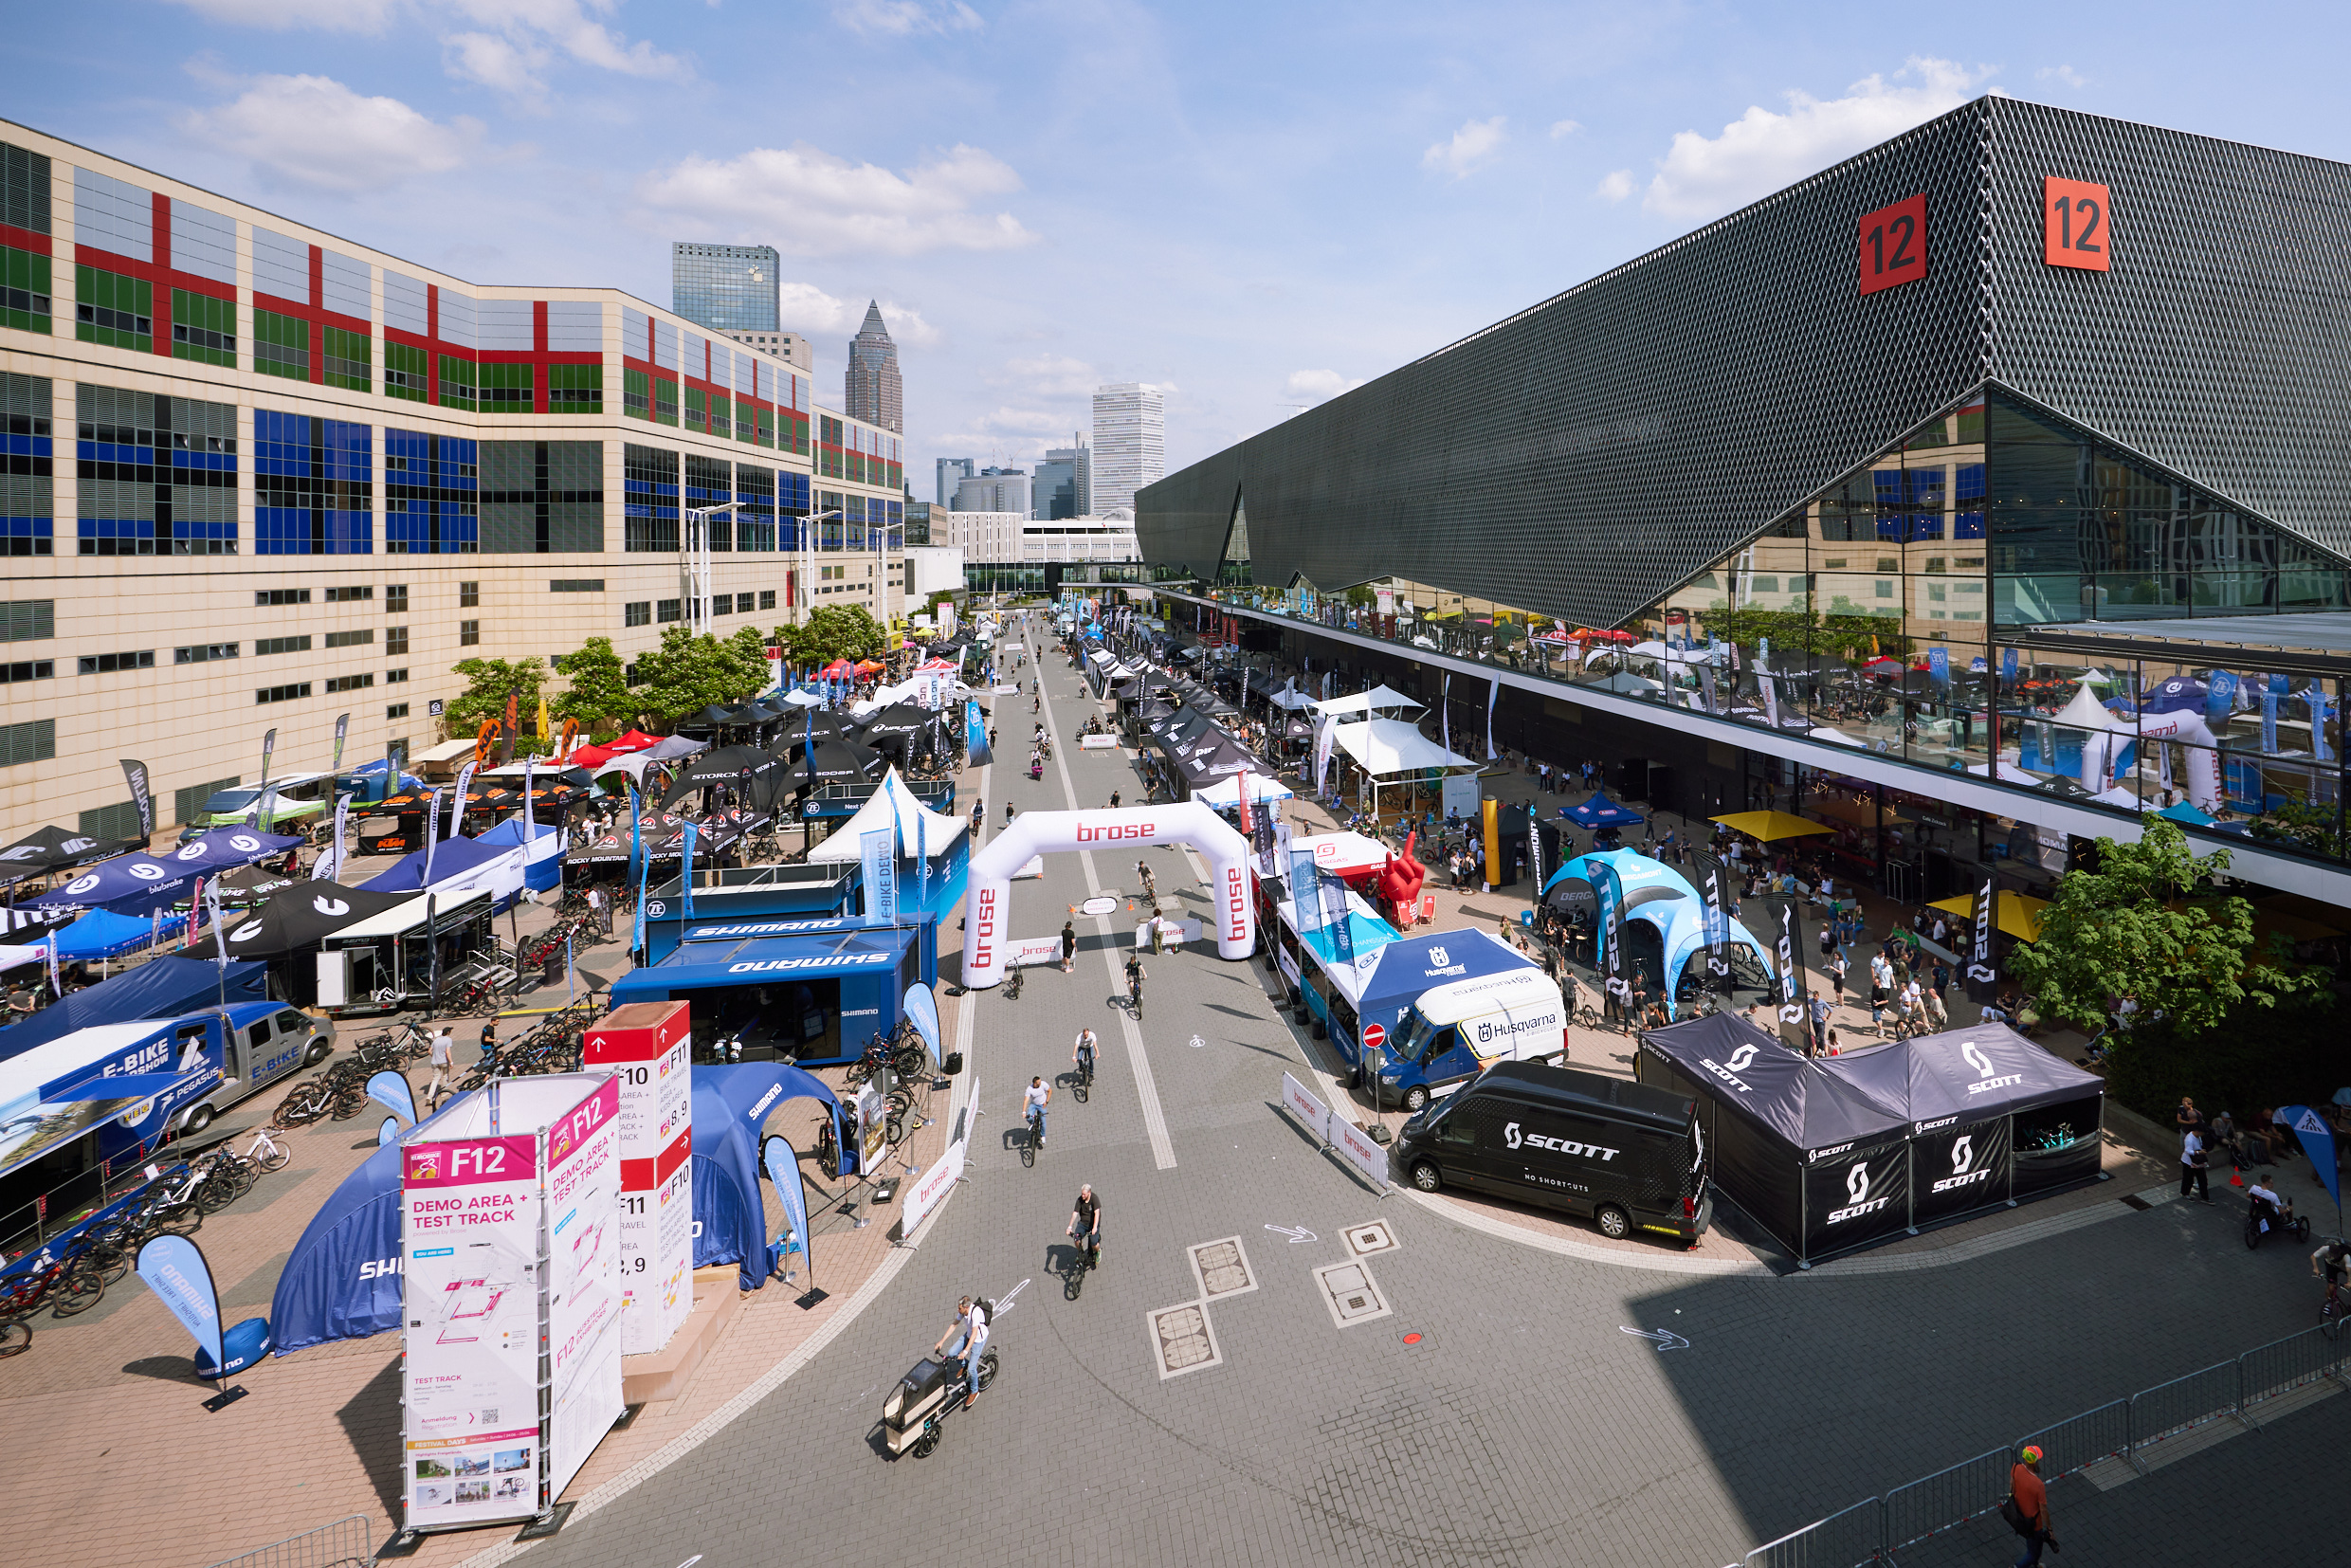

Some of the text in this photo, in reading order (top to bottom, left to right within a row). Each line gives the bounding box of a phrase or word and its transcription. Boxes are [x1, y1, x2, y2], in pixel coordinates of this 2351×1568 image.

[2054, 195, 2100, 252] 12
[1867, 215, 1915, 275] 12
[505, 694, 519, 731] KTM
[478, 722, 499, 754] KTM
[561, 721, 578, 753] KTM
[691, 771, 739, 780] STORCK
[382, 795, 414, 804] KTM
[485, 788, 506, 799] KTM
[1077, 821, 1155, 842] brose
[376, 837, 406, 848] KTM
[567, 855, 629, 866] ROCKY MOUNTAIN.
[648, 851, 668, 860] OCKY
[1619, 868, 1663, 882] BERGAMONT
[149, 877, 184, 895] blubrake
[648, 903, 665, 913] ZF
[1227, 866, 1246, 941] brose
[44, 911, 75, 926] TRAFFIC
[693, 920, 843, 937] SHIMANO
[970, 888, 995, 969] brose
[1163, 928, 1185, 937] rose
[1022, 944, 1056, 956] brose
[728, 952, 891, 973] SHIMANO
[1425, 963, 1466, 977] Husqvarna
[1452, 978, 1517, 996] Husqvarna
[841, 1009, 878, 1017] SHIMANO
[1494, 1012, 1556, 1038] Husqvarna
[102, 1037, 169, 1078] E-BIKE
[251, 1044, 301, 1080] E-BIKE
[670, 1043, 686, 1070] F11
[1646, 1043, 1671, 1064] SCOTT
[176, 1066, 219, 1099] PEGASUS
[250, 1056, 301, 1088] ROADSHOW
[1699, 1058, 1753, 1093] SCOTT
[1968, 1073, 2022, 1095] SCOTT
[681, 1100, 687, 1116] 9
[748, 1083, 783, 1121] SHIMANO
[1293, 1087, 1317, 1119] brose
[123, 1103, 150, 1123] ZEG
[573, 1096, 603, 1141] F12
[1923, 1116, 1959, 1133] SCOTT
[410, 1152, 442, 1160] EUROBIKE
[1343, 1129, 1372, 1162] brose
[1523, 1133, 1620, 1161] SCOTT
[1816, 1142, 1854, 1158] SCOTT
[450, 1146, 505, 1177] F12
[553, 1158, 583, 1192] DEMO
[586, 1137, 609, 1162] AREA
[553, 1177, 577, 1206] TEST
[579, 1151, 610, 1182] TRACK
[671, 1164, 689, 1196] F10
[920, 1165, 949, 1204] brose
[1539, 1176, 1590, 1193] SHORTCUTS
[1931, 1169, 1990, 1194] SCOTT
[413, 1198, 462, 1212] DEMO
[467, 1194, 513, 1209] AREA
[1826, 1195, 1889, 1225] SCOTT
[413, 1210, 515, 1229] TEST TRACK
[634, 1257, 646, 1272] 9
[576, 1298, 609, 1337] AUSSTELLER
[576, 1308, 607, 1345] EXHIBITORS
[556, 1335, 574, 1368] F12
[421, 1414, 457, 1424] Anmeldung
[421, 1422, 457, 1431] Registration
